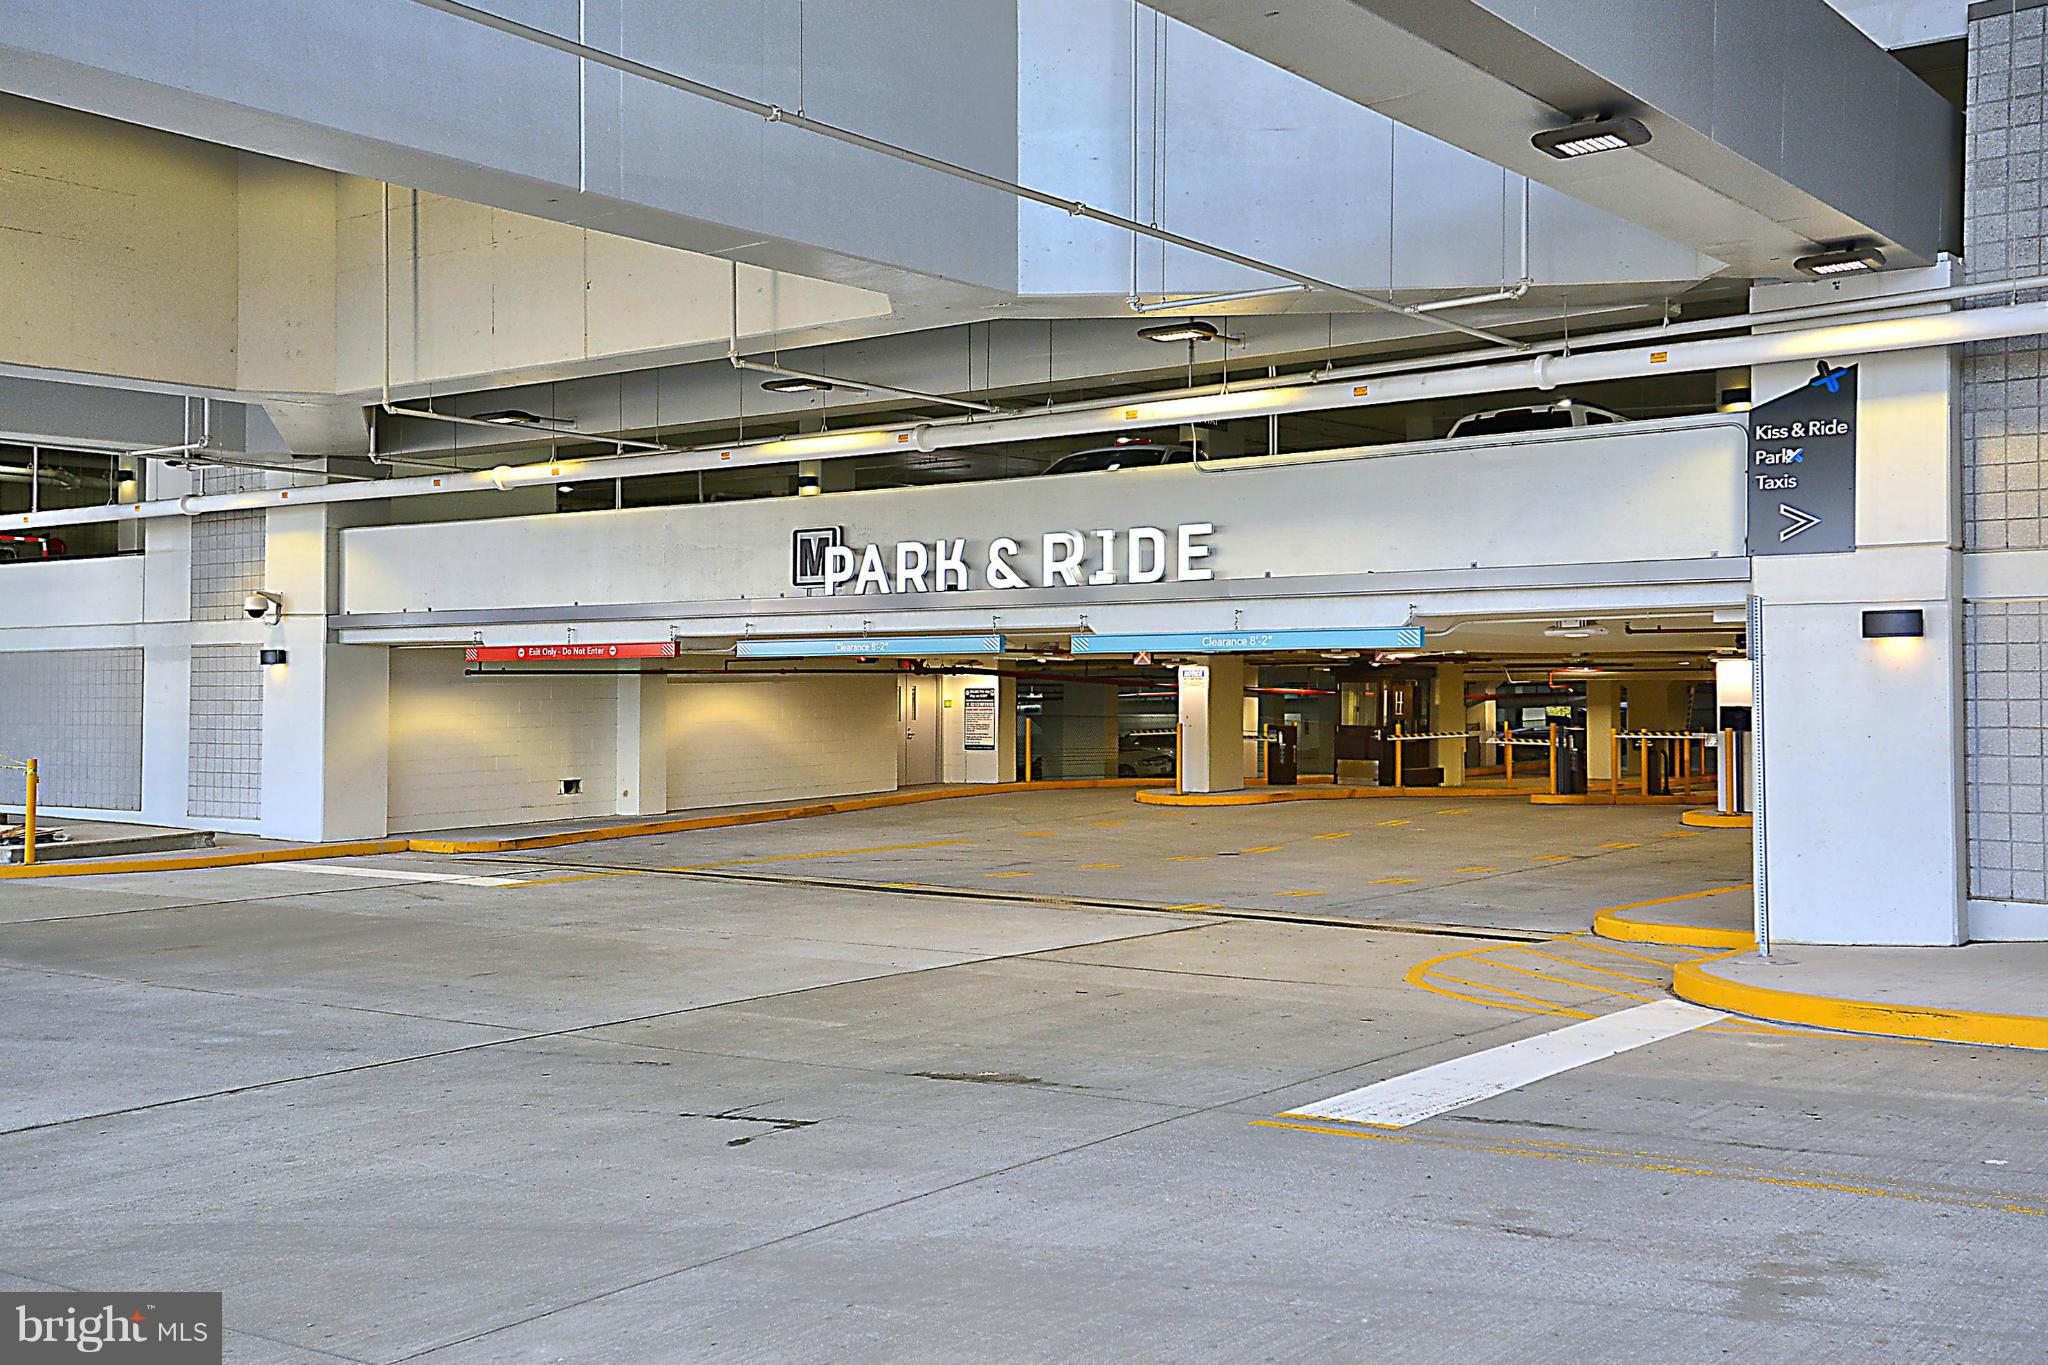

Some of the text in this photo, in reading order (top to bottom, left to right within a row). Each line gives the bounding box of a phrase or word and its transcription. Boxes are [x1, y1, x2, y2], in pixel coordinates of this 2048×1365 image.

[1755, 418, 1849, 440] Kiss & Ride
[1755, 474, 1798, 490] Taxis
[824, 522, 1214, 596] PARK & RIDE
[835, 643, 869, 652] Clearance
[1202, 636, 1247, 647] Clearance
[528, 648, 541, 656] Exit
[543, 648, 557, 658] Only
[562, 648, 571, 656] Do
[587, 647, 604, 655] Enter
